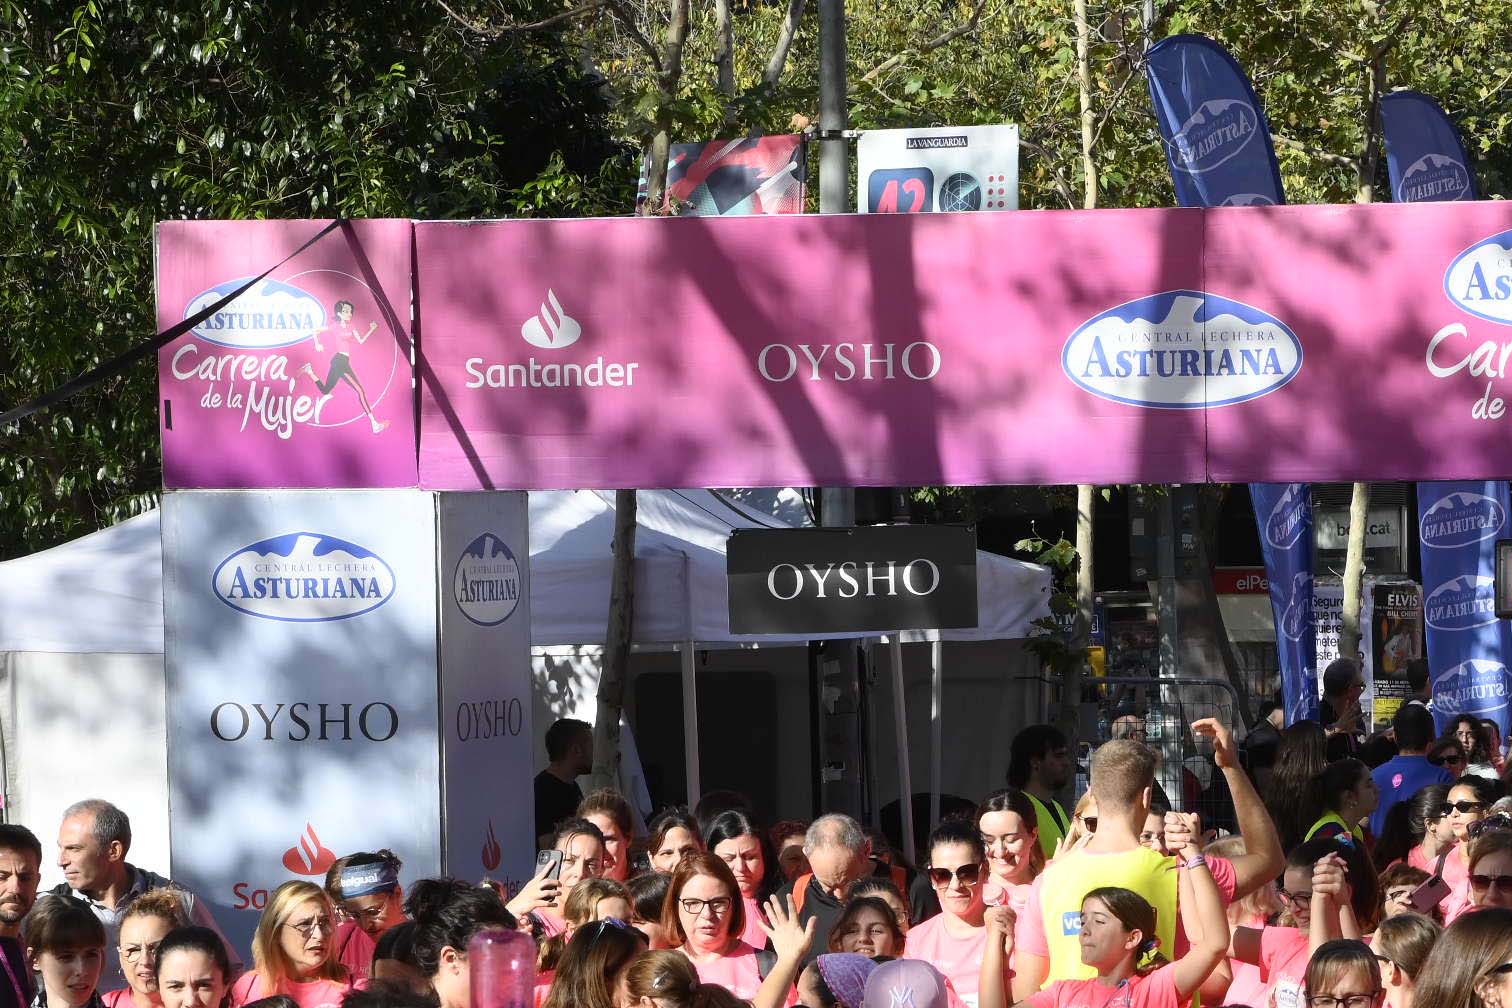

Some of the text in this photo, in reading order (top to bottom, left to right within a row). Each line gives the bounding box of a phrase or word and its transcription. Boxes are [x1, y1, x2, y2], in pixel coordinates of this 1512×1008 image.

[918, 136, 966, 147] VANGUARDIA
[1200, 329, 1276, 342] LECHERA
[171, 343, 289, 382] Carrera
[464, 356, 639, 389] Santander
[758, 341, 942, 382] OYSHO
[1081, 335, 1284, 378] ASTURIANA
[200, 376, 334, 440] de la Mujer
[1471, 381, 1506, 421] de
[227, 566, 383, 600] ASTURIANA
[459, 568, 517, 603] ASTURIANA
[767, 558, 940, 600] OYSHO
[1387, 594, 1418, 607] ELVIS
[209, 701, 400, 743] OYSHO
[457, 698, 523, 743] OYSHO
